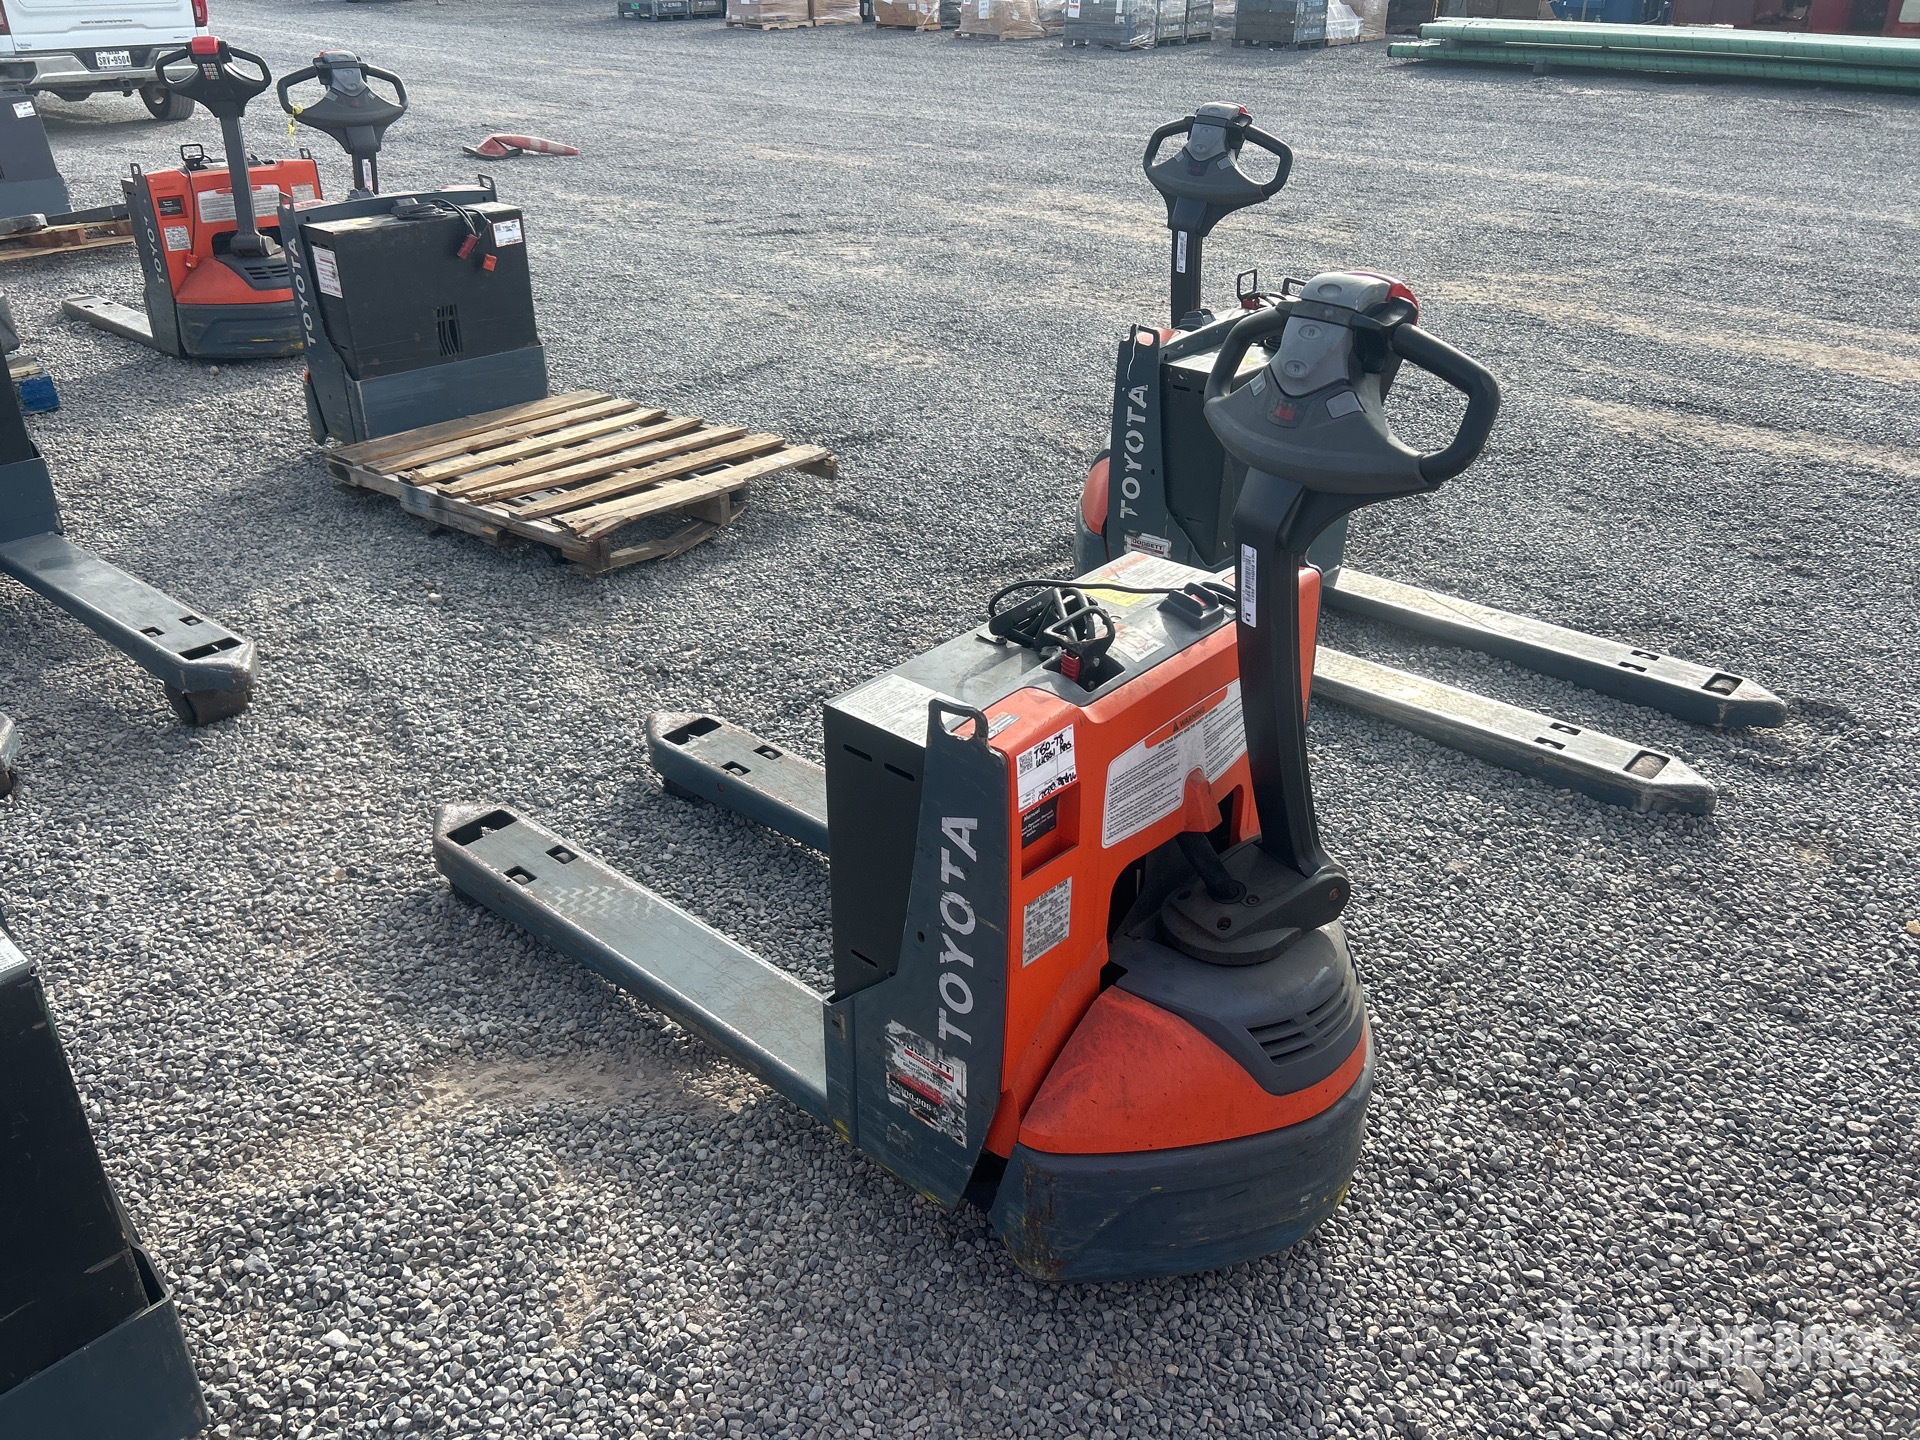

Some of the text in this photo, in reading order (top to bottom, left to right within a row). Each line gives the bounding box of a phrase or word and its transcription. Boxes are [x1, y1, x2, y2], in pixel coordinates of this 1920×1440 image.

[288, 238, 316, 347] TOYOTA
[1119, 384, 1149, 519] TOYOTA
[1179, 706, 1206, 727] WARNING
[938, 816, 978, 1045] TOYOTA
